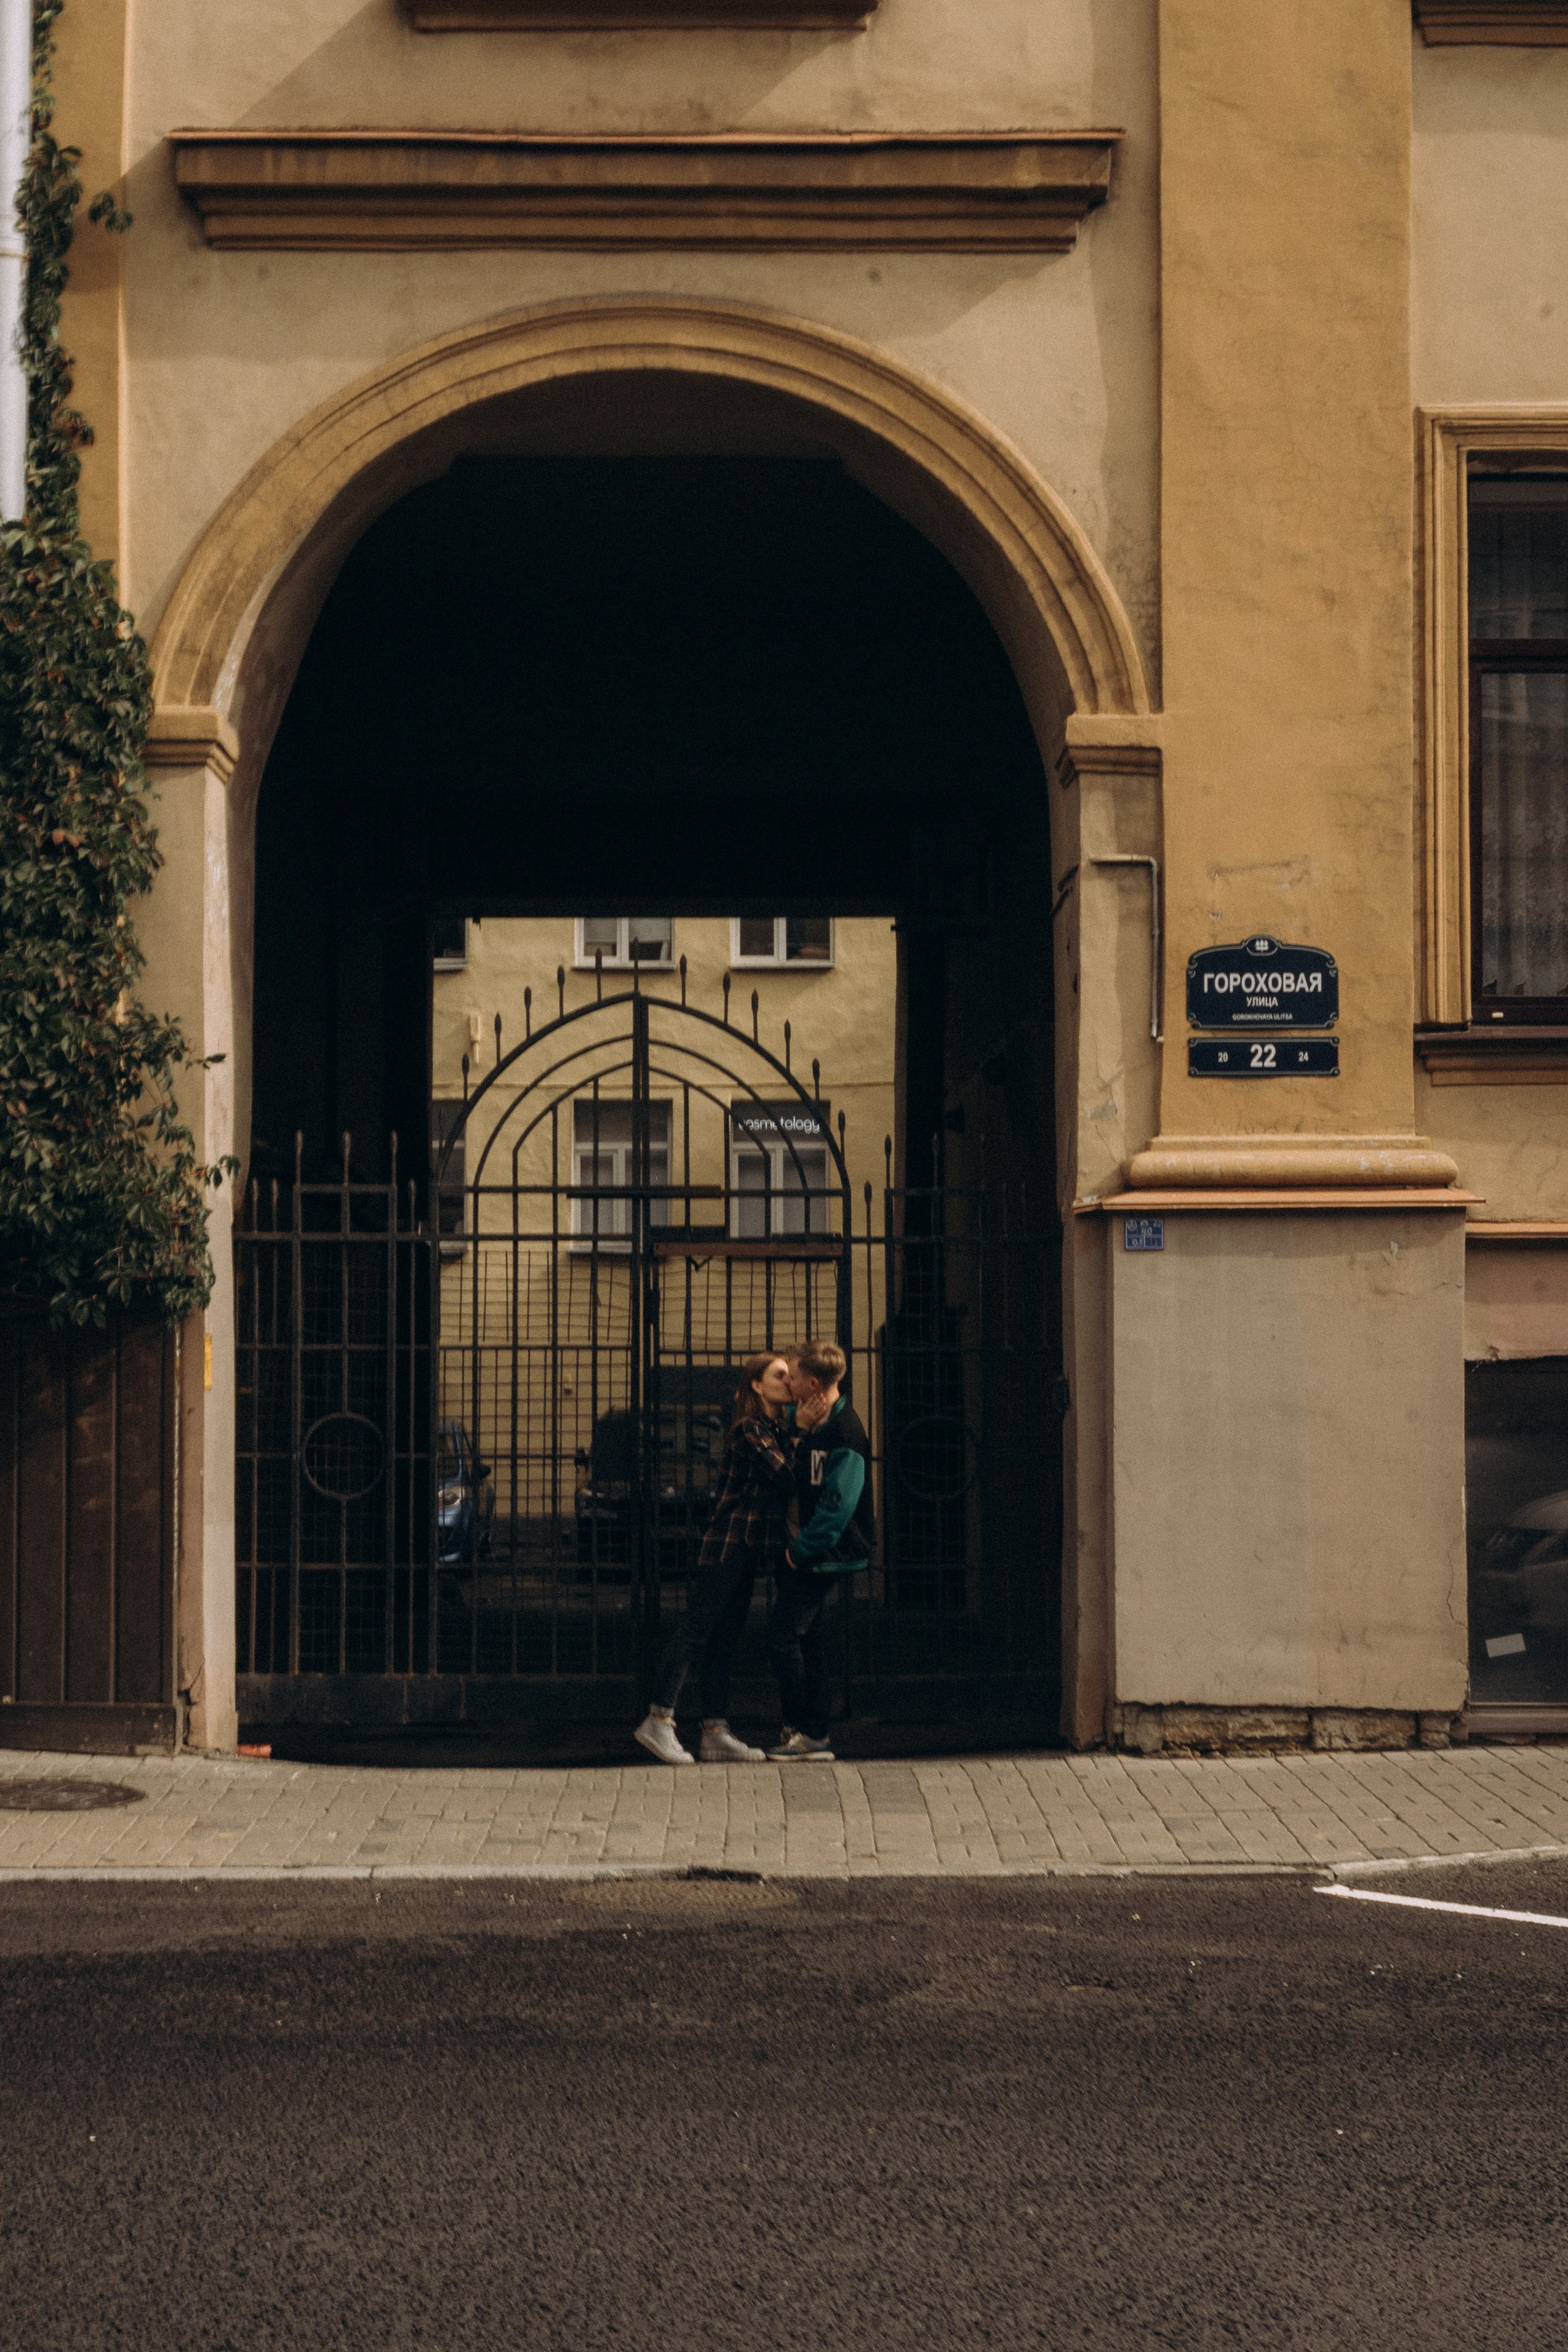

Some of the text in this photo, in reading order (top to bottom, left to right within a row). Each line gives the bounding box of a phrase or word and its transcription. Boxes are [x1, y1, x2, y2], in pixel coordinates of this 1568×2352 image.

[1204, 972, 1322, 993] ГОРОХОВАЯ
[1246, 996, 1279, 1008] УЛИЦА
[1218, 1044, 1309, 1068] 20 22 24
